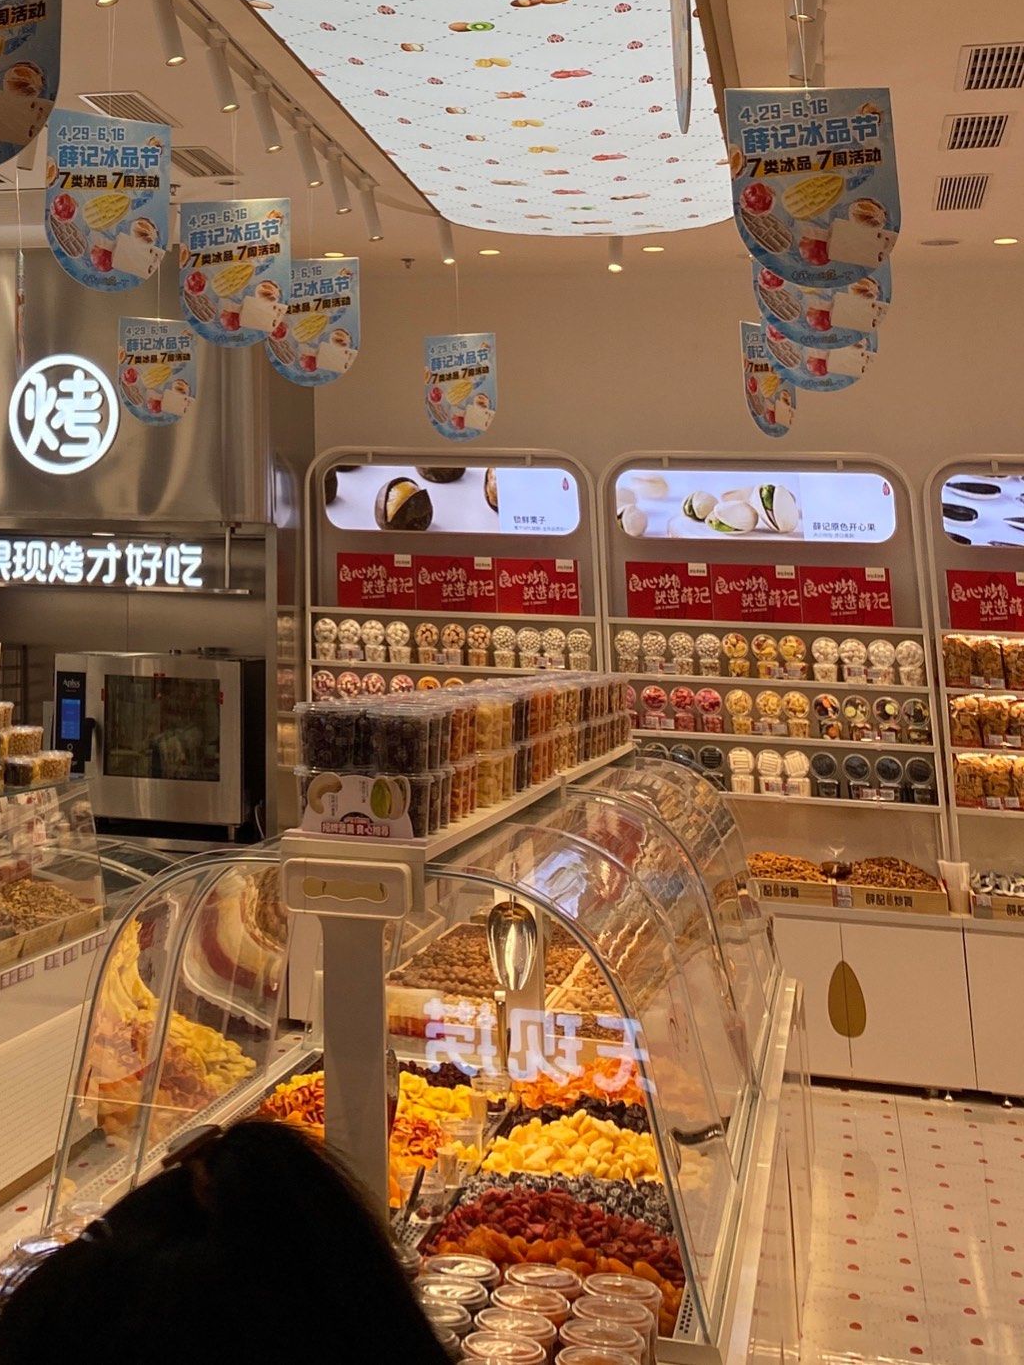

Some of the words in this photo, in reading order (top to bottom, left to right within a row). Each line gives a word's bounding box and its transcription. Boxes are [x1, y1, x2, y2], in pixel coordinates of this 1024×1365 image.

[739, 99, 828, 124] 4.29-6.16
[58, 127, 125, 143] 4.29-6.16
[742, 116, 880, 155] 薛记冰品节
[58, 145, 161, 168] 薛记冰品节
[747, 155, 812, 178] 7类冰品
[816, 148, 882, 172] 7周活动
[59, 172, 108, 189] 7类冰品
[112, 172, 160, 189] 7周活动
[189, 209, 247, 227] 4.29-6.16
[189, 219, 281, 251] 薛记冰品节
[191, 248, 233, 267] 7类冰品
[237, 242, 280, 261] 7周活动
[126, 336, 190, 352] 薛记冰品节
[25, 370, 103, 458] 烤
